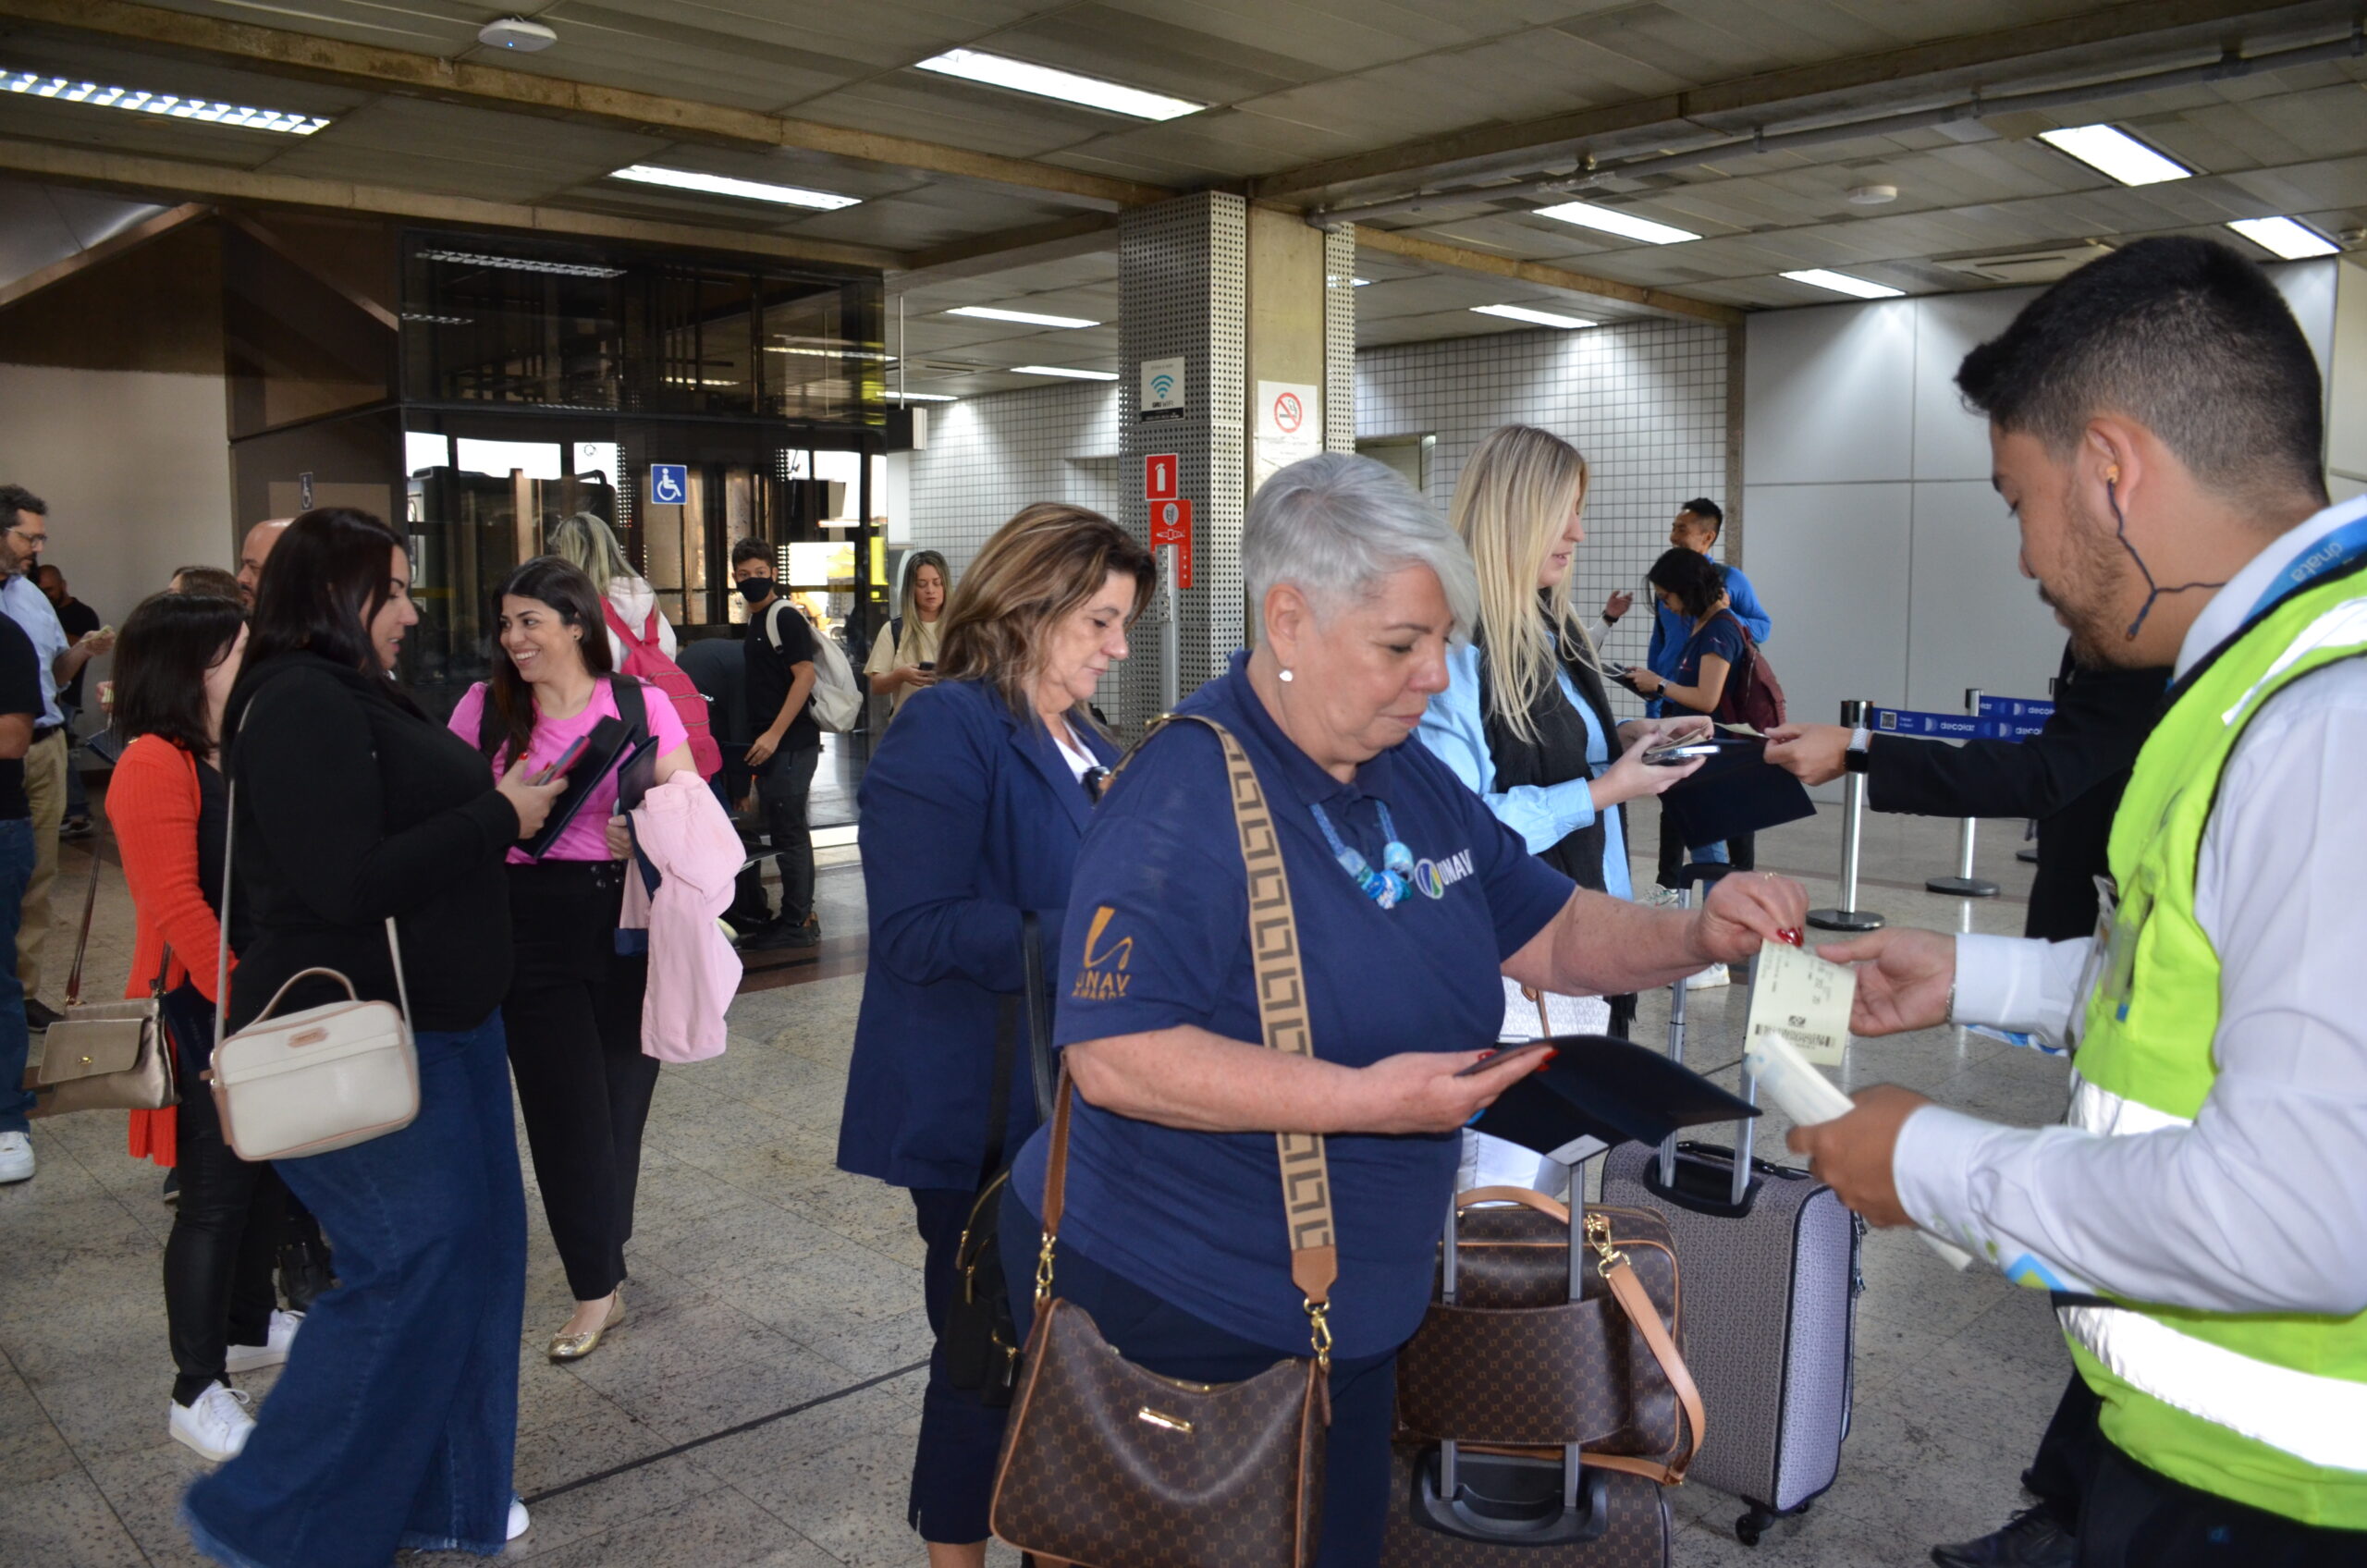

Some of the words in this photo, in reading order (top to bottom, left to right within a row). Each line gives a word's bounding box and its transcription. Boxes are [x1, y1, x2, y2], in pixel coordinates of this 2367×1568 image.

[2291, 542, 2343, 582] dnata
[1940, 721, 1975, 732] decolar
[1437, 849, 1474, 886] UNAV
